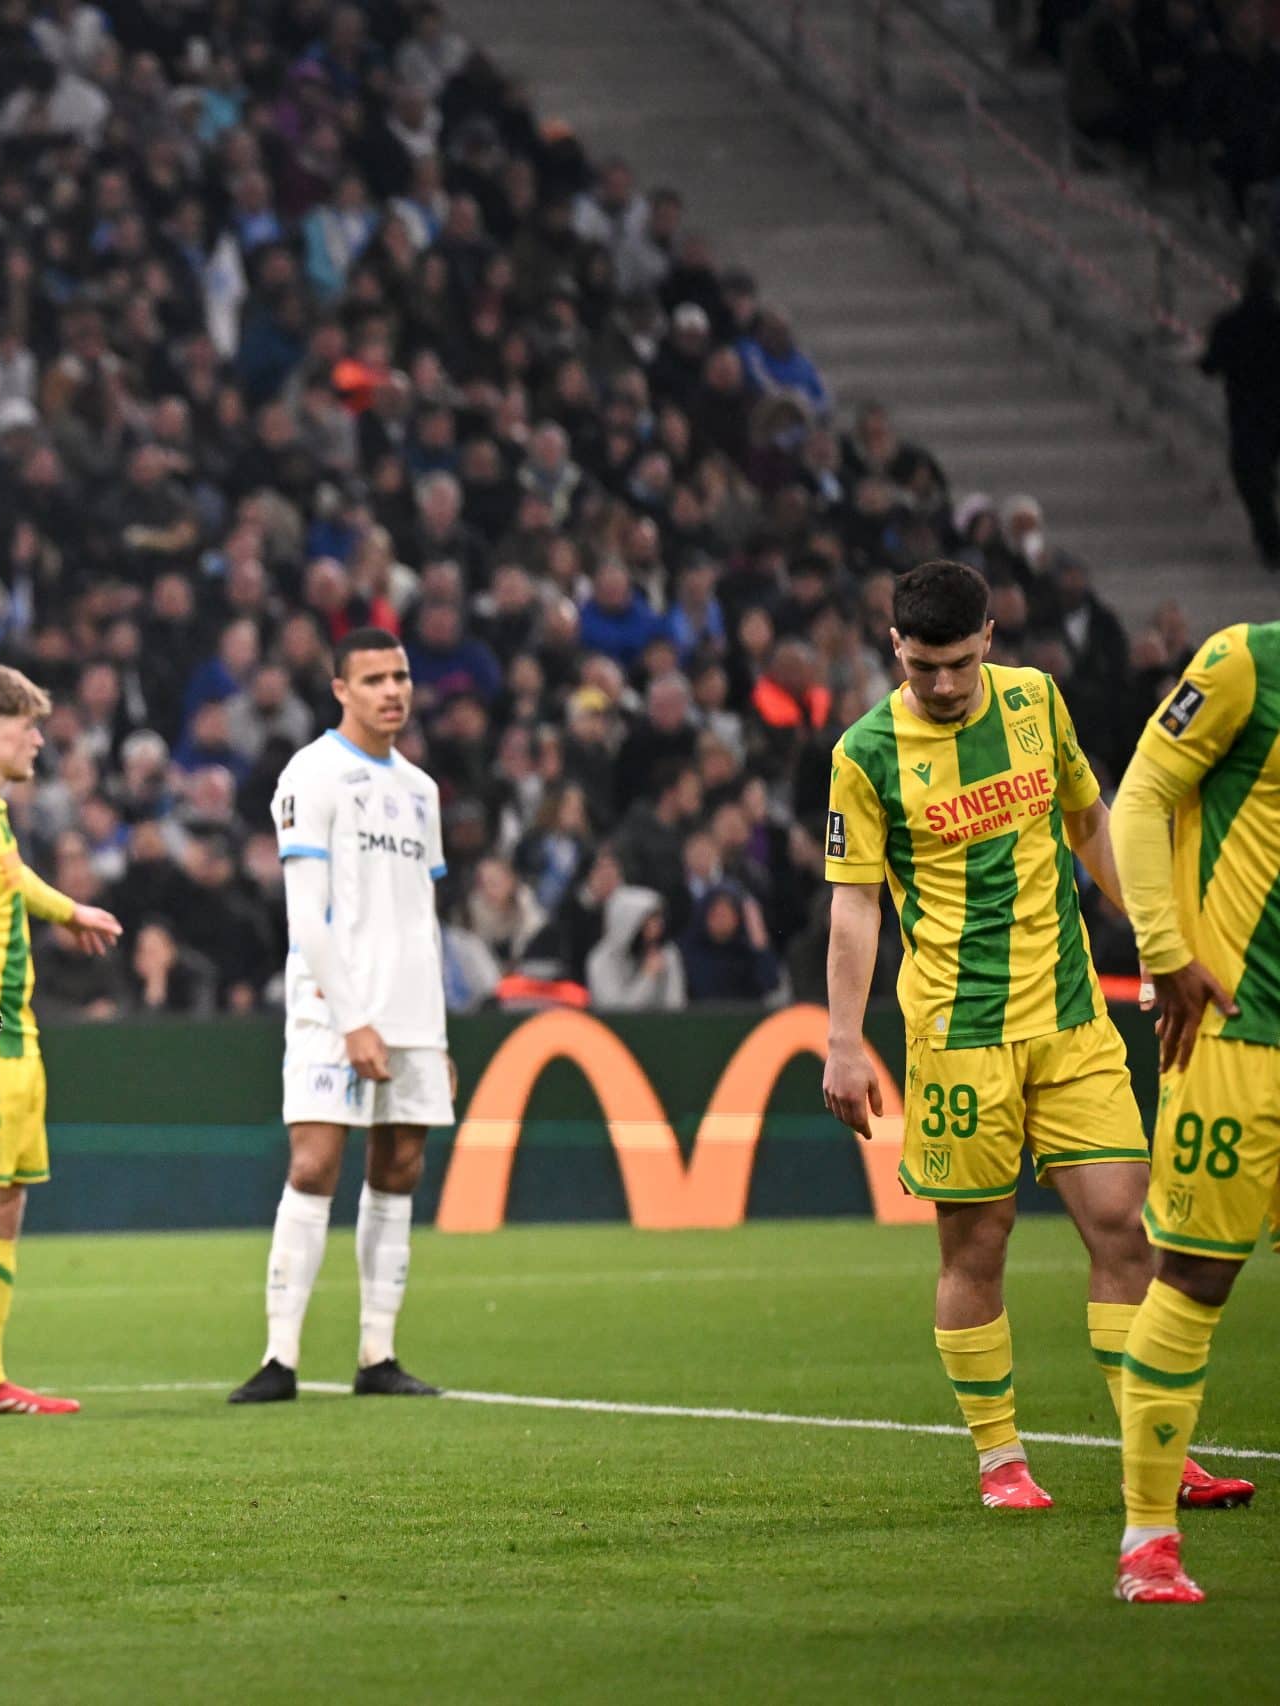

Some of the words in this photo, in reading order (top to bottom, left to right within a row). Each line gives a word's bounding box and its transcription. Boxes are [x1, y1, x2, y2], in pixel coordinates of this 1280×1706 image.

[924, 768, 1052, 832] SYNERGIE
[940, 811, 1023, 846] INTERIM
[921, 1083, 978, 1138] 39
[1173, 1111, 1243, 1180] 98
